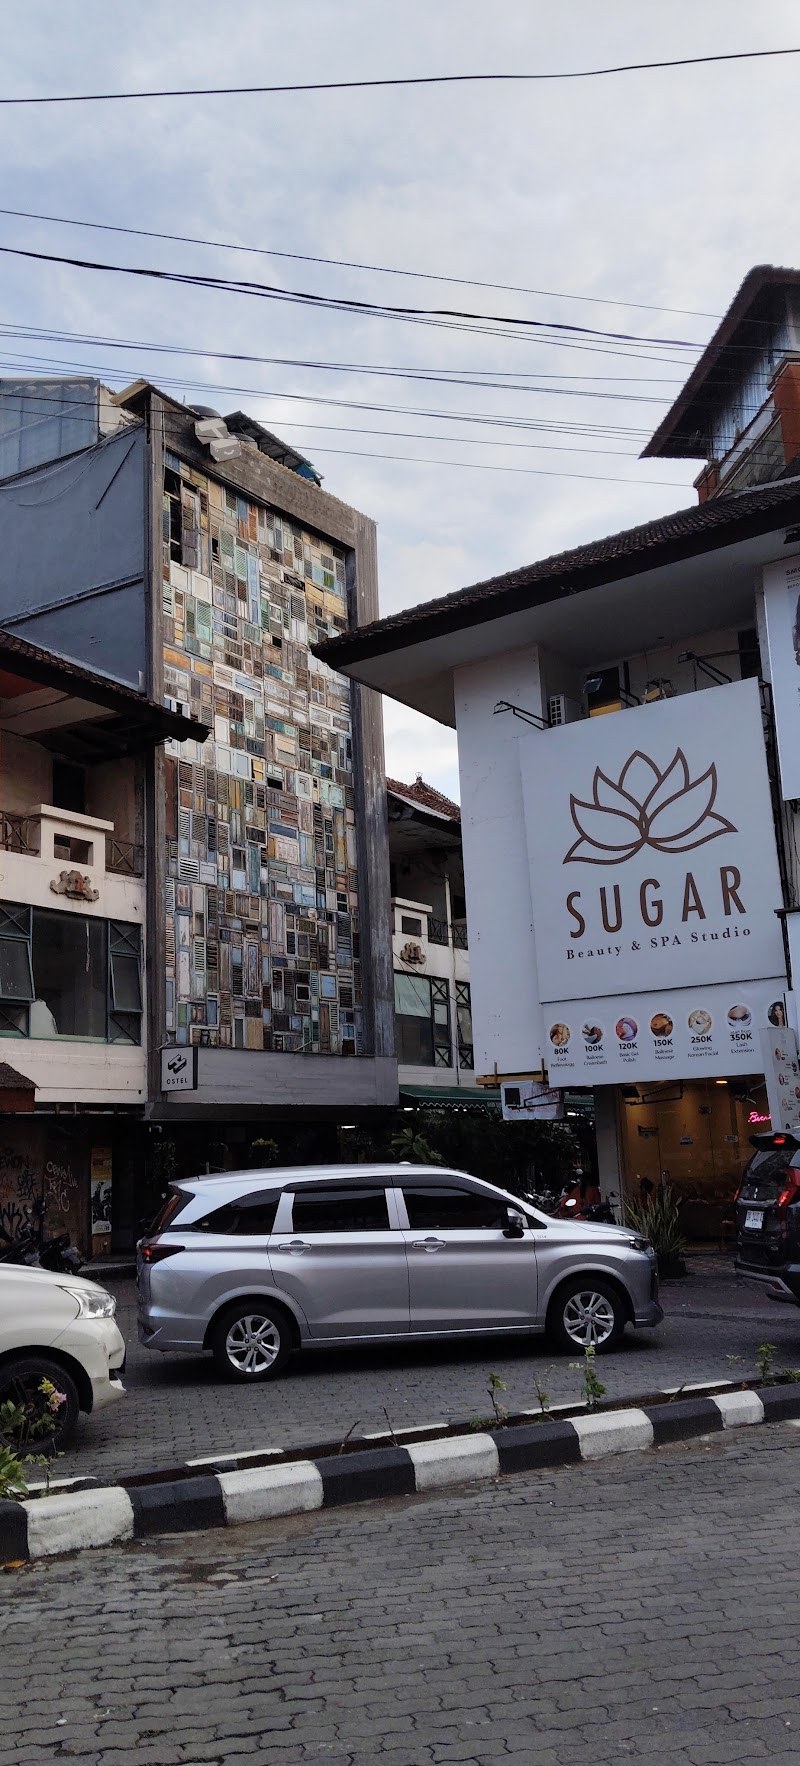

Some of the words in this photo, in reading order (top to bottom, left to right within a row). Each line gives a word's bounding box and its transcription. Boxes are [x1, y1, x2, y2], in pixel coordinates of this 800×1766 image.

[566, 866, 747, 938] SUGAR
[566, 944, 623, 960] Beauty
[631, 940, 641, 951] &
[650, 935, 682, 948] SPA
[690, 927, 751, 943] Studio
[691, 1035, 712, 1044] 250K
[730, 1032, 753, 1041] 350K
[653, 1038, 673, 1046] 150K
